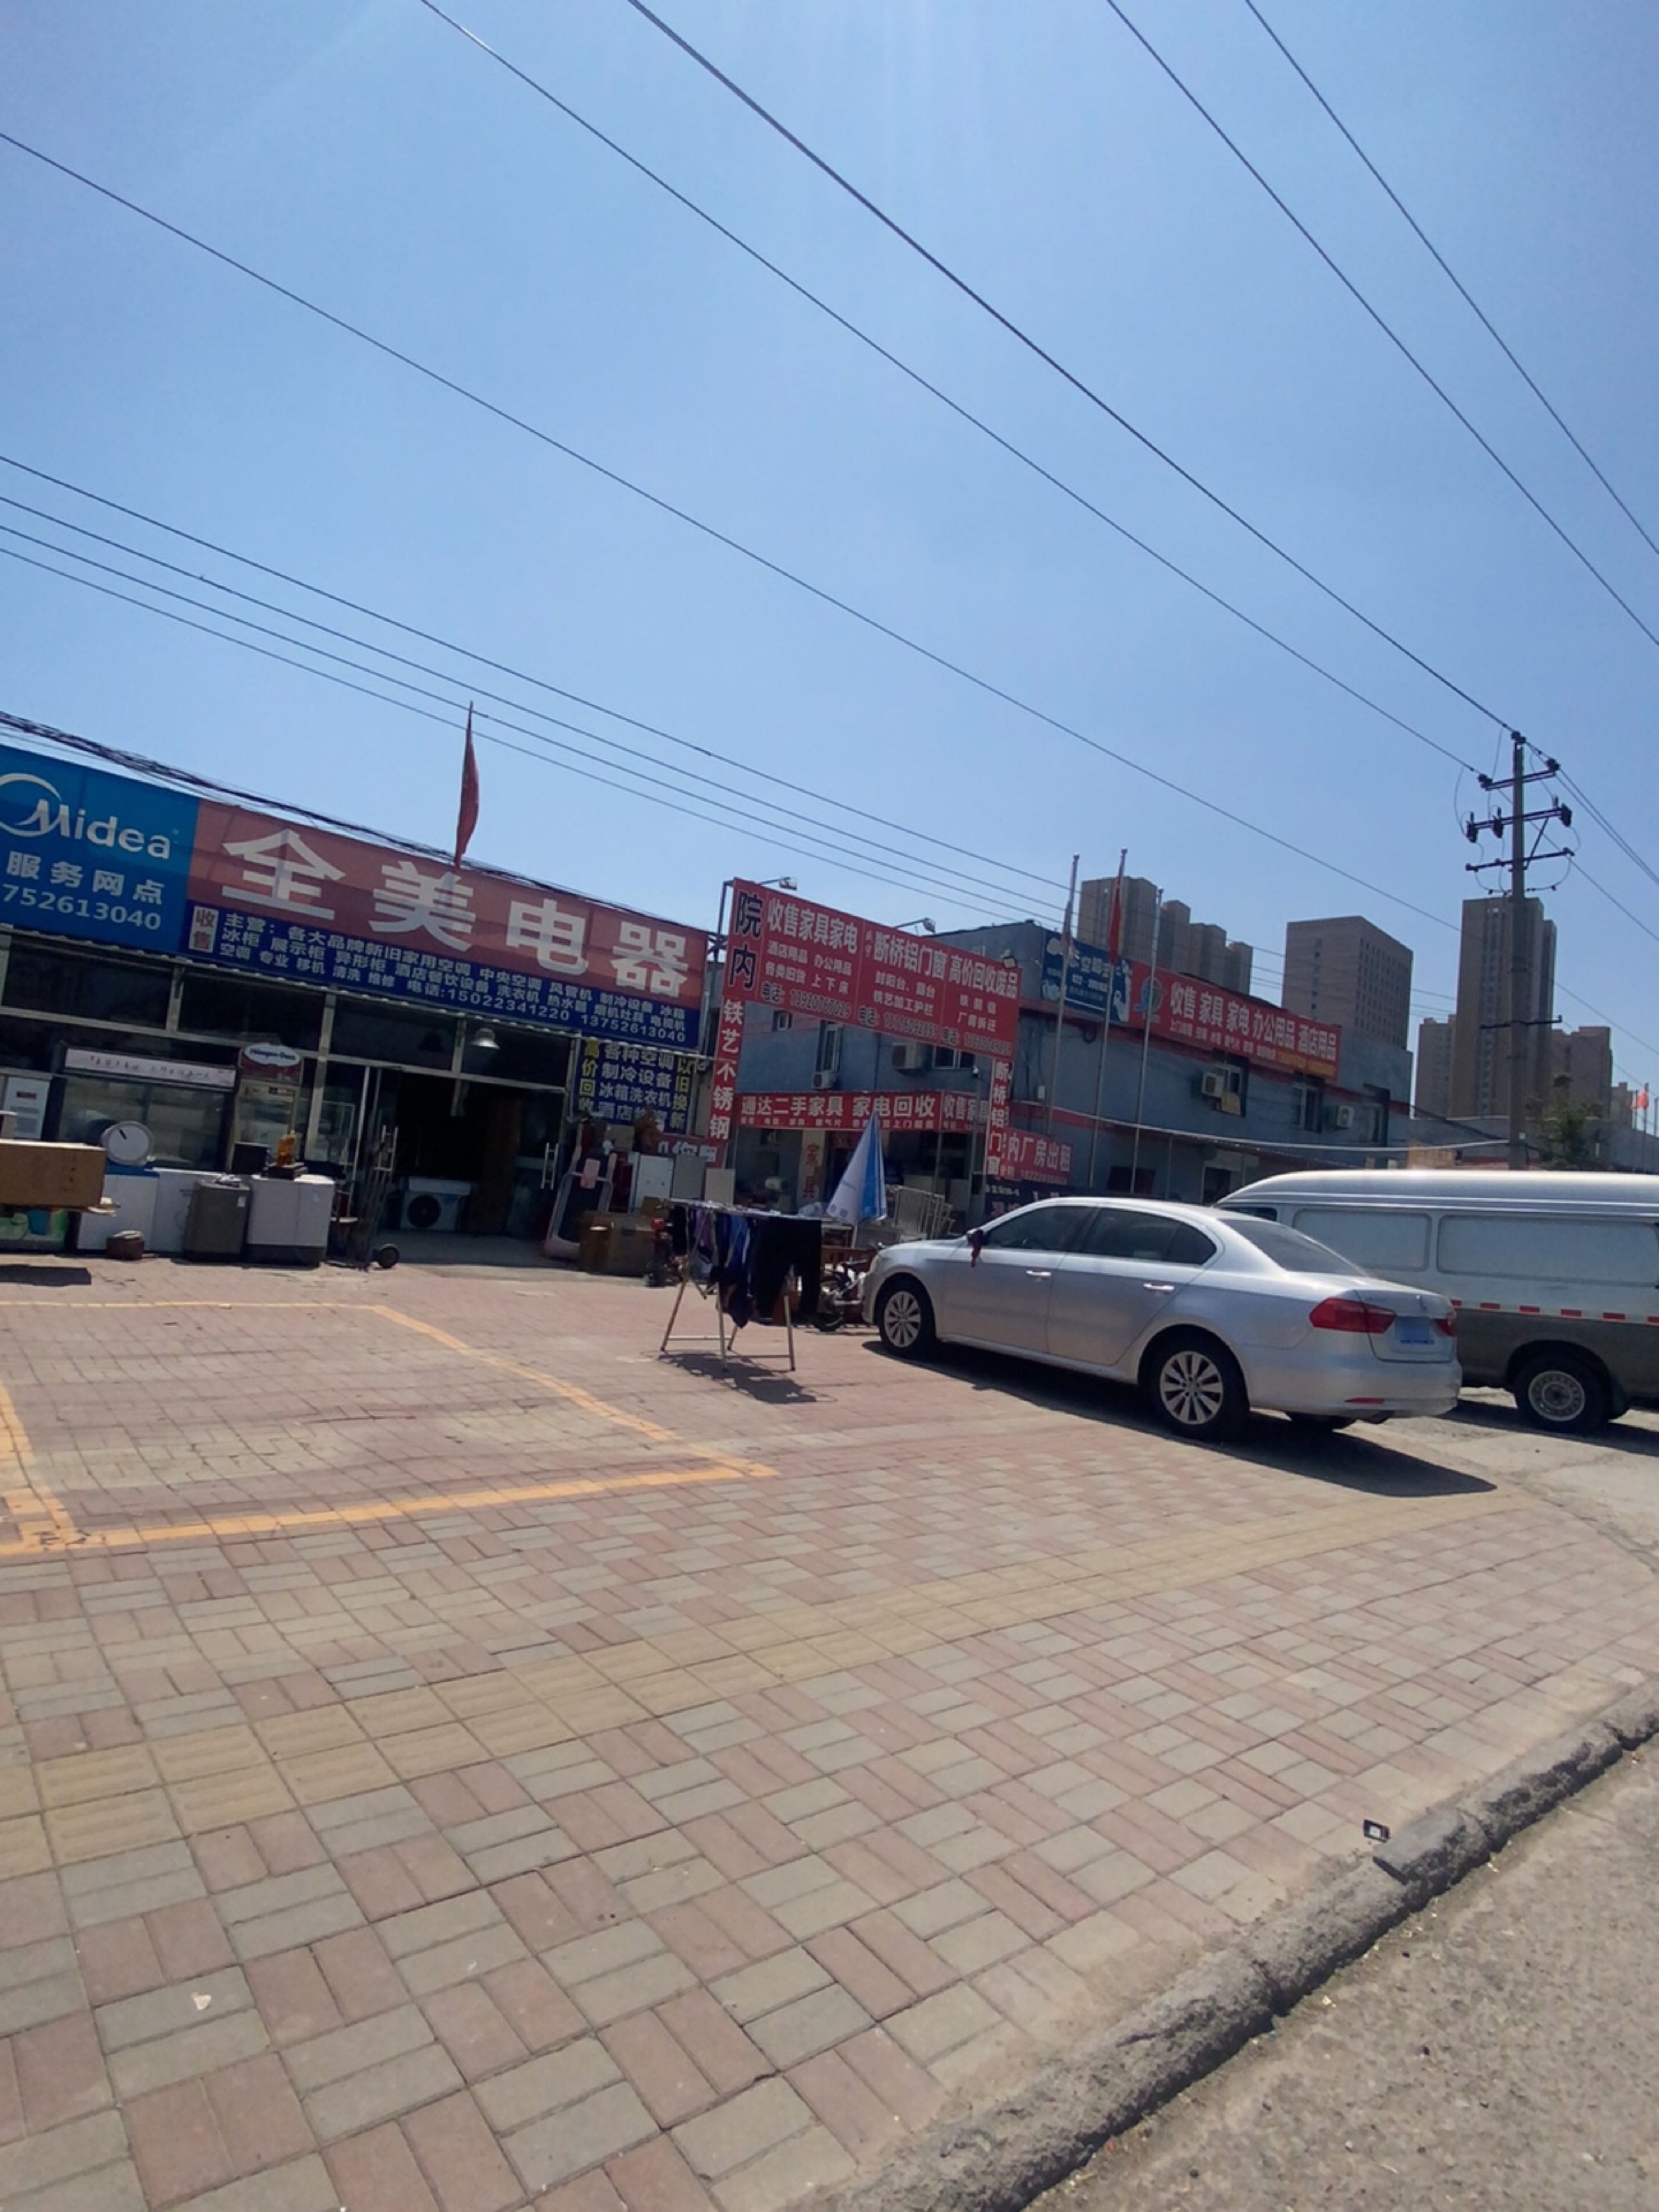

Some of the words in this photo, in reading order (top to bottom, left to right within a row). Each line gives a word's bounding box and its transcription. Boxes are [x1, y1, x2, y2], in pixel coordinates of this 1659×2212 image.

[14, 799, 171, 860] Midea
[6, 851, 165, 905] 服务网点
[1, 884, 162, 931] 752613040
[221, 829, 688, 997] 全美电器
[768, 897, 858, 954] 收售家具家电
[728, 890, 764, 991] 院内
[581, 1014, 686, 1043] 13752613040
[1170, 982, 1197, 1020] 收售
[1199, 992, 1224, 1028] 家具
[1226, 1000, 1249, 1036] 家电
[1253, 1009, 1295, 1050] 办公用品
[1298, 1023, 1337, 1061] 酒店用品
[602, 1063, 673, 1089] 制冷设备
[605, 1042, 674, 1071] 各种空调
[709, 1000, 744, 1141] 铁艺不锈钢
[599, 1082, 671, 1108] 冰箱洗衣机
[741, 1095, 844, 1117] 通达二手家具
[852, 1094, 936, 1118] 家电回收
